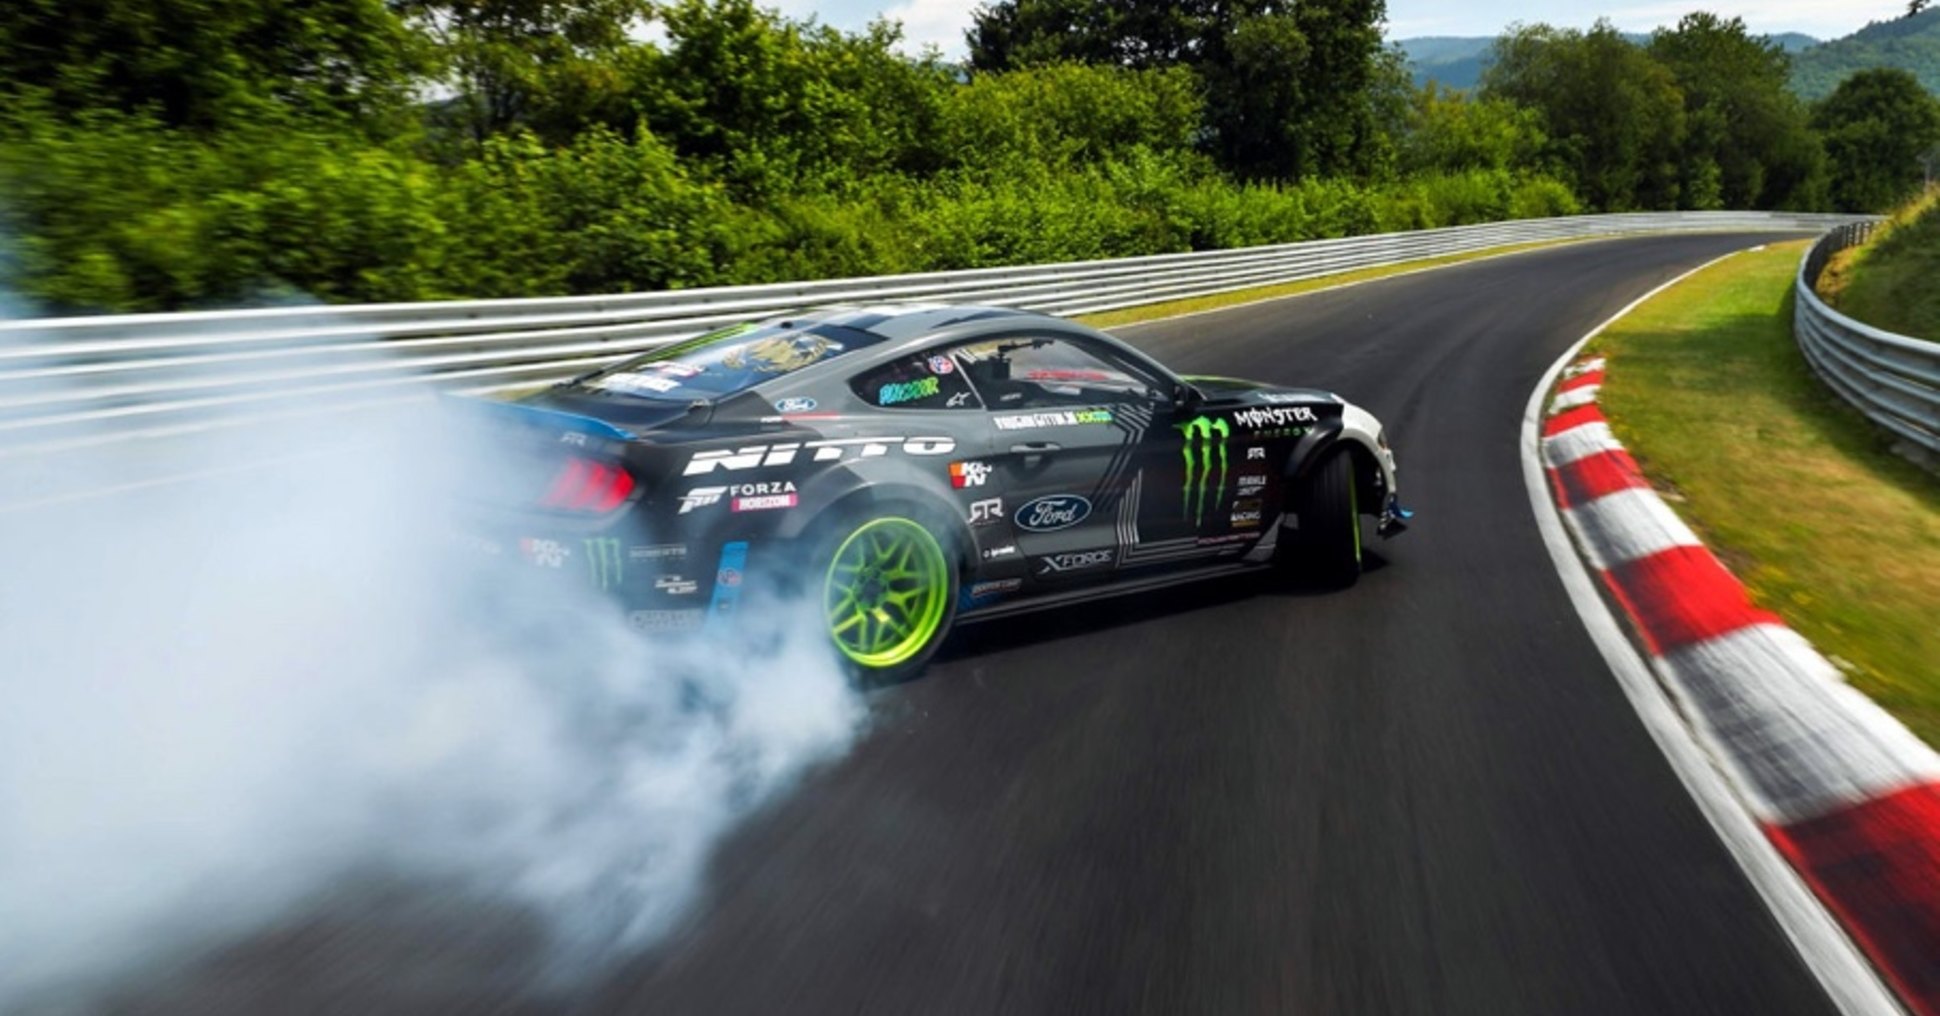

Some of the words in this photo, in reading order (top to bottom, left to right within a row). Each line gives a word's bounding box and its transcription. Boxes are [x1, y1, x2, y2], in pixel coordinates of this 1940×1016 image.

[683, 437, 956, 477] NITTO
[730, 481, 797, 497] FORZA
[738, 494, 792, 511] HORIZON
[1028, 499, 1079, 527] Ford
